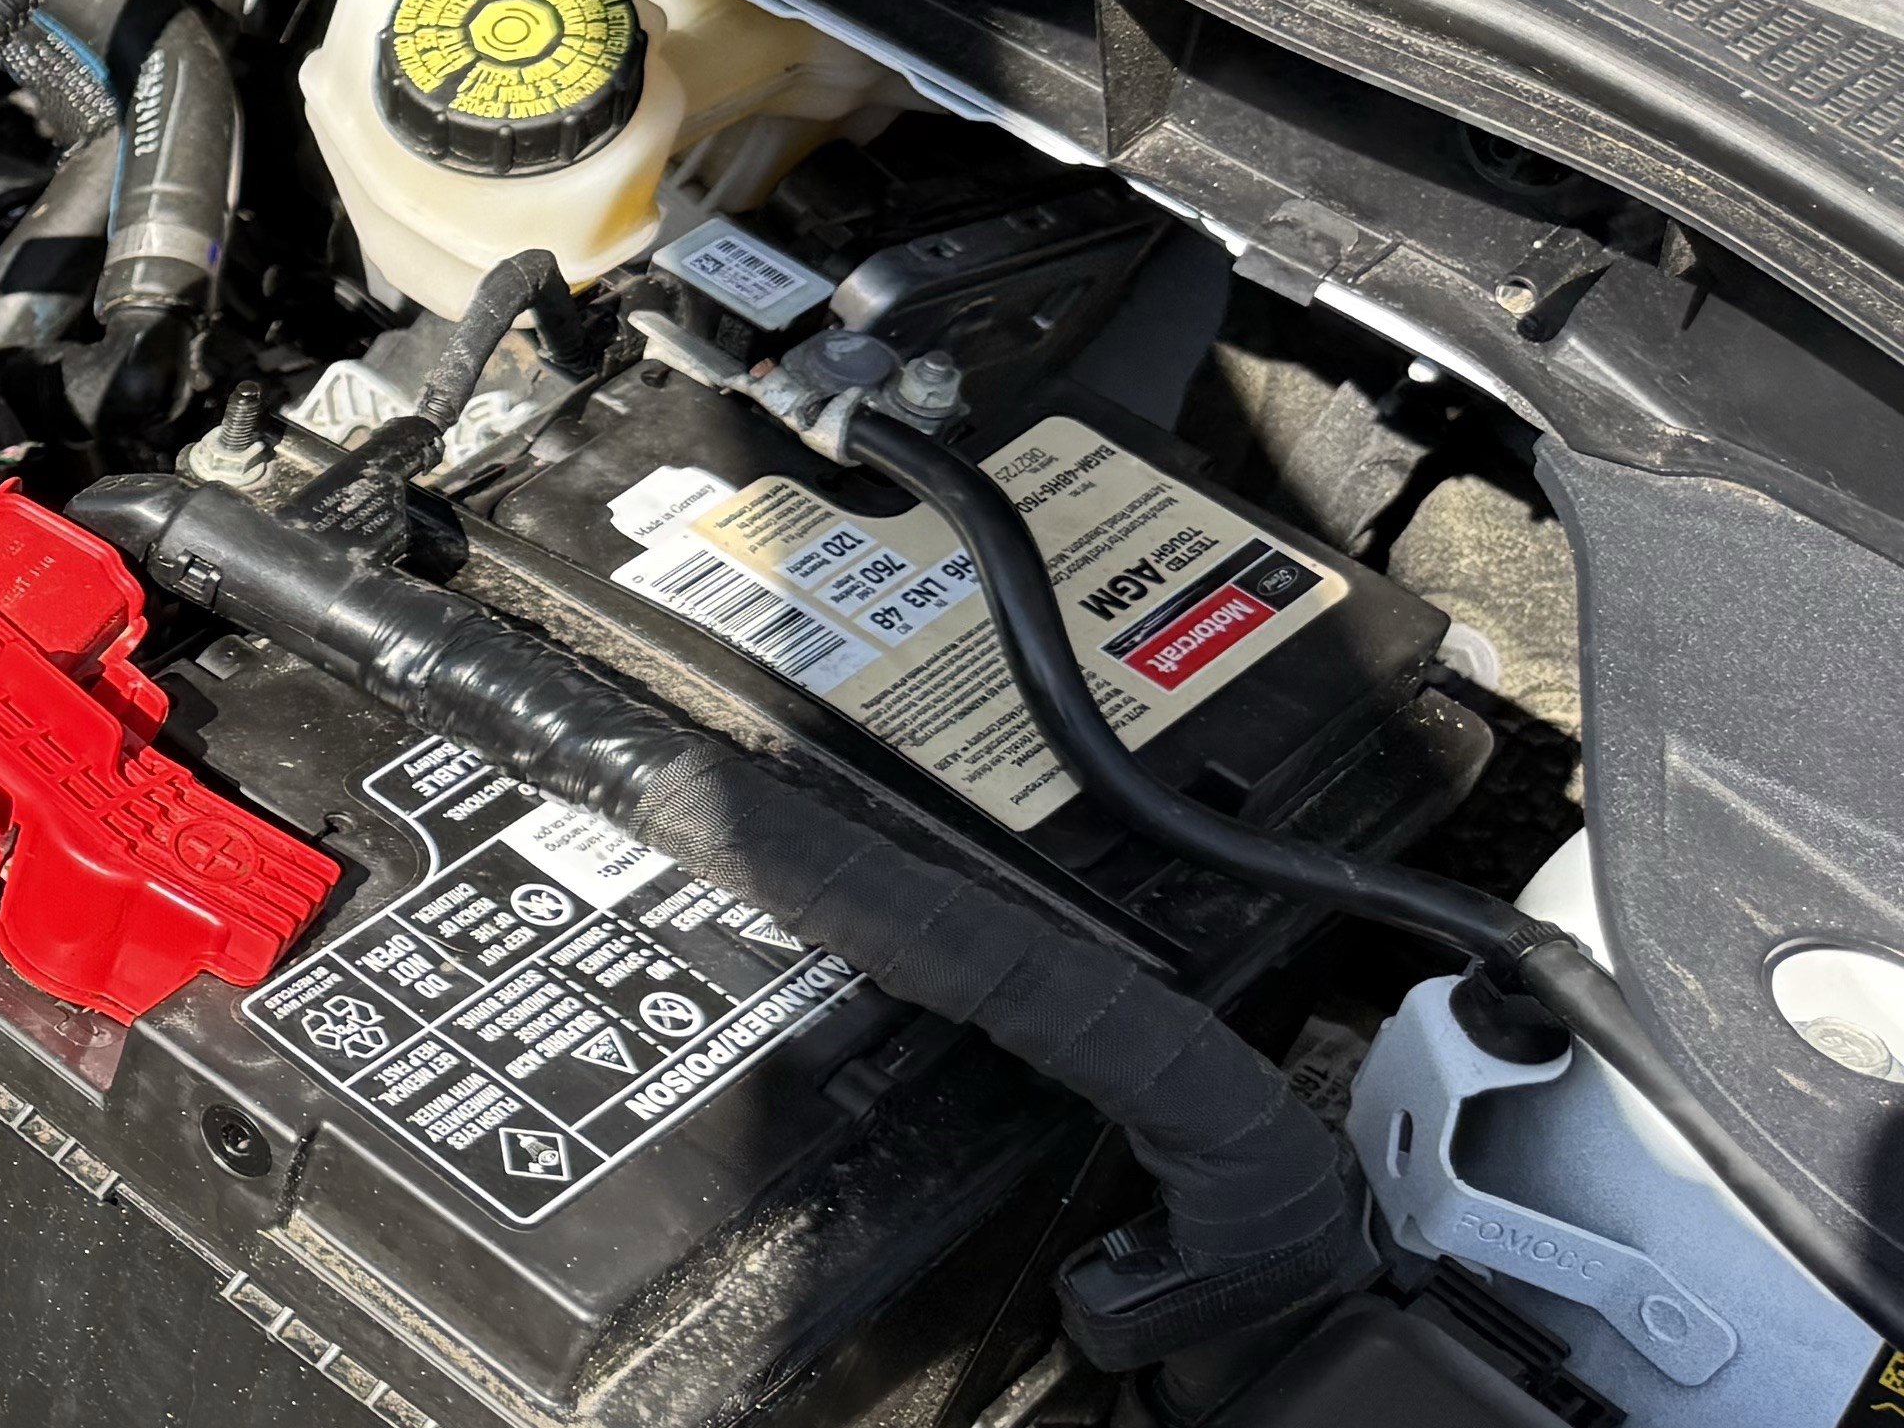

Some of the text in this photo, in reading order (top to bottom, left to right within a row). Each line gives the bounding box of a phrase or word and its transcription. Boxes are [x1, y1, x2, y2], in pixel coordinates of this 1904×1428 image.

[389, 35, 444, 94] CONTAINER
[508, 96, 556, 118] AVANT
[633, 480, 715, 540] Made in Germany
[1099, 508, 1132, 532] Road,
[1116, 494, 1178, 539] Manufactured
[1122, 484, 1166, 516] American
[784, 549, 821, 575] Capacity
[818, 527, 865, 560] 120
[1062, 523, 1108, 557] Dearborn,
[1086, 541, 1113, 559] Ford
[1105, 533, 1125, 547] for
[1161, 532, 1219, 574] TESTED
[856, 551, 907, 587] 760
[1064, 554, 1095, 576] Motor
[1256, 564, 1299, 594] Ford
[855, 585, 877, 601] Cold
[866, 553, 980, 631] H6 LN3 48
[1076, 554, 1174, 624] AGM
[1142, 594, 1256, 678] Motorcraft
[398, 736, 459, 780] Battery
[440, 771, 517, 827] RUCTIONS.
[541, 820, 588, 854] handling
[594, 840, 653, 883] NING:
[408, 878, 476, 927] CHILDREN.
[433, 893, 496, 939] REACH OF
[667, 896, 719, 933] GASES
[467, 908, 517, 944] OF THE
[475, 923, 537, 967] KEEP OUT
[547, 923, 608, 967] SMOKING
[352, 929, 417, 976] OPEN.
[384, 950, 434, 987] NOT
[573, 936, 626, 974] FLAMES
[593, 950, 646, 988] SPARKS
[642, 956, 676, 982] NO
[261, 964, 331, 1012] BE RECYCLED
[269, 971, 343, 1021] BATTERY MUST
[411, 970, 453, 1001] DO
[449, 966, 544, 1033] SEVERE BURNS.
[475, 979, 564, 1043] BLINDNESS OR
[511, 993, 582, 1045] CAN CAUSE
[371, 1037, 442, 1088] HELP FAST.
[425, 1049, 459, 1074] GET
[503, 1007, 605, 1080] SULFURIC ACID
[619, 963, 838, 1121] DANGER/POISON
[404, 1070, 488, 1129] WITH WATER.
[420, 1082, 504, 1142] IMMEDIATELY
[444, 1095, 521, 1150] FLUSH EYES
